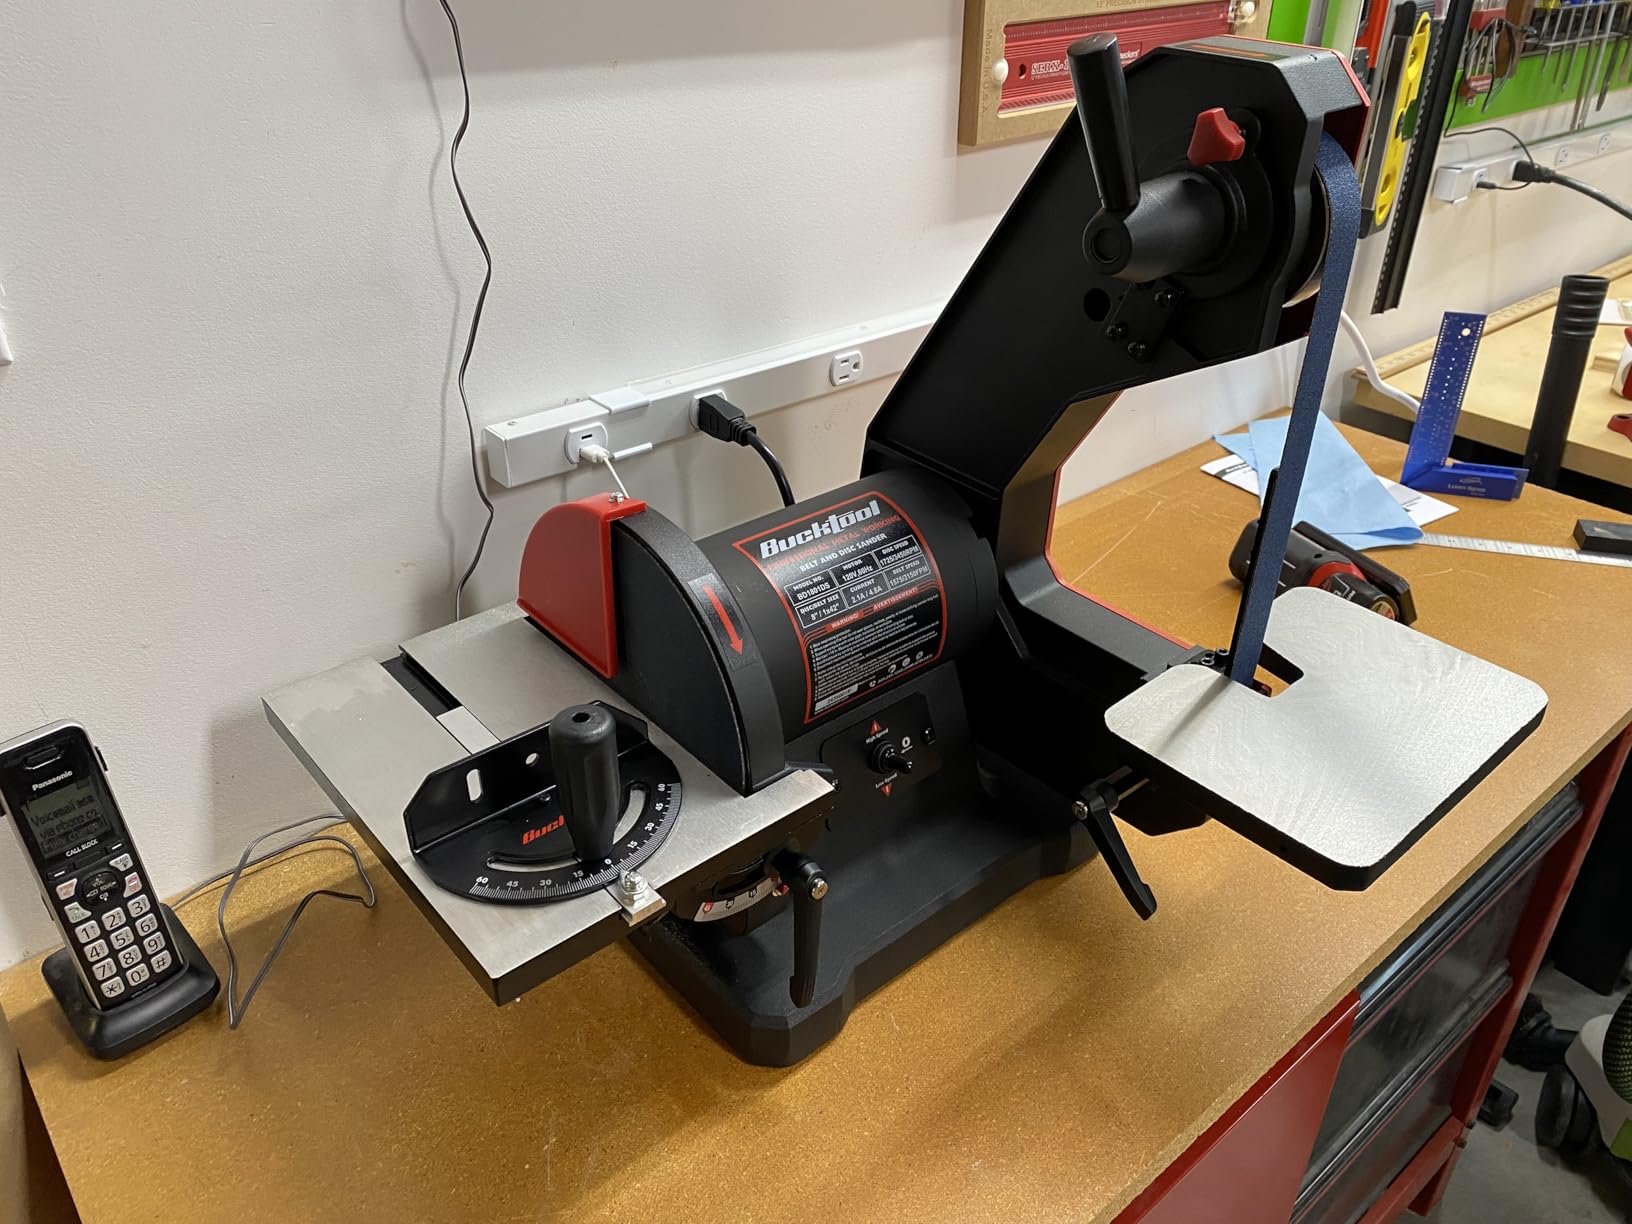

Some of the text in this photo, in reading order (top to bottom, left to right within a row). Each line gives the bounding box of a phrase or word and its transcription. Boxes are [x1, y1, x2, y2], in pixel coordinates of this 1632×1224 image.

[760, 500, 880, 559] Bucktool
[800, 533, 888, 573] BELT AND DISC SANDER
[882, 546, 895, 555] DISC
[842, 559, 863, 571] MOTOR
[793, 580, 813, 591] MODEL
[850, 578, 875, 593] CURRENT
[32, 770, 73, 791] Panasonic
[644, 822, 655, 832] 30
[627, 840, 638, 849] 15
[65, 847, 82, 857] CALL
[476, 876, 489, 885] 60
[572, 870, 584, 878] 15
[506, 880, 519, 888] 45
[131, 901, 143, 914] 3
[107, 915, 119, 928] 2
[140, 921, 151, 933] 6
[81, 927, 91, 940] 1
[114, 934, 126, 947] 5
[147, 939, 158, 952] 9
[90, 946, 101, 959] 4
[123, 951, 135, 965] 8
[95, 965, 106, 978] 7
[131, 970, 141, 983] 0
